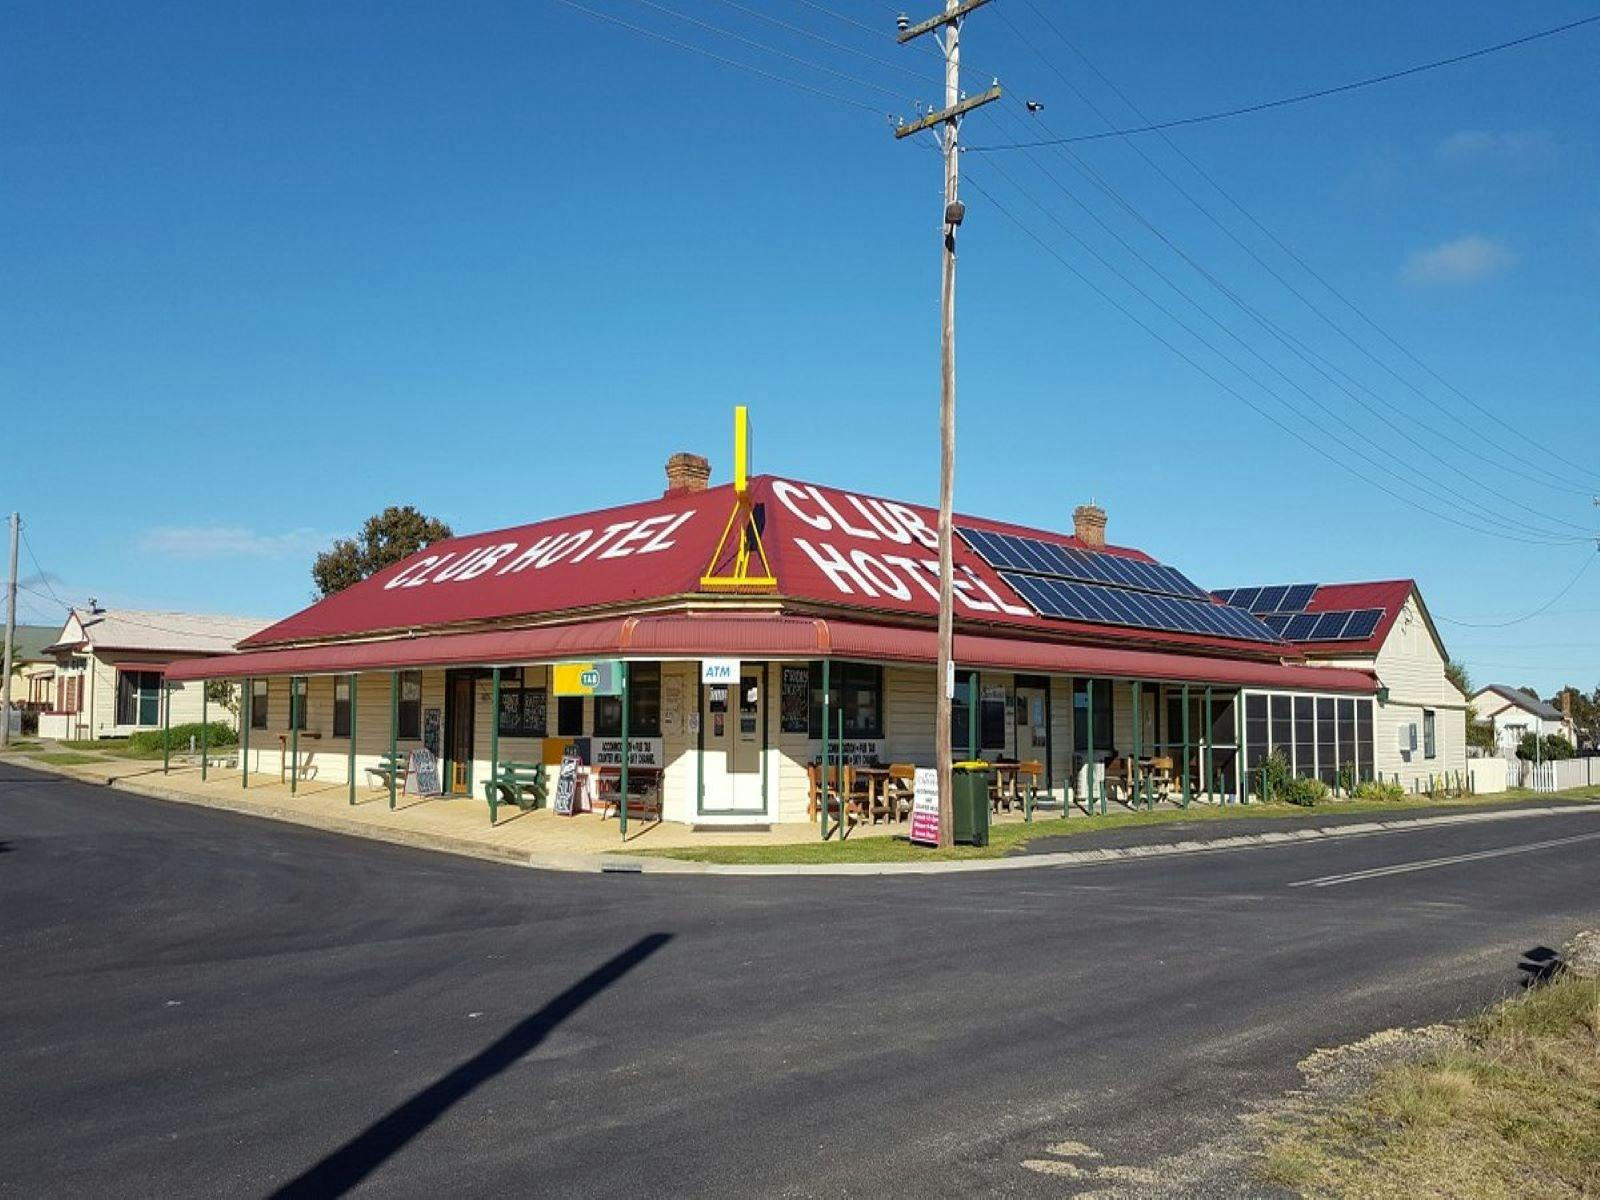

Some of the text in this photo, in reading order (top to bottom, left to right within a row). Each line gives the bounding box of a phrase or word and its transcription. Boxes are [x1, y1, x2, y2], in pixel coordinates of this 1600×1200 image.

[772, 480, 940, 548] CLUB
[384, 509, 697, 590] CLUB HOTEL
[793, 537, 1034, 618] HOTEL
[583, 674, 598, 684] TAB
[705, 665, 730, 678] ATM
